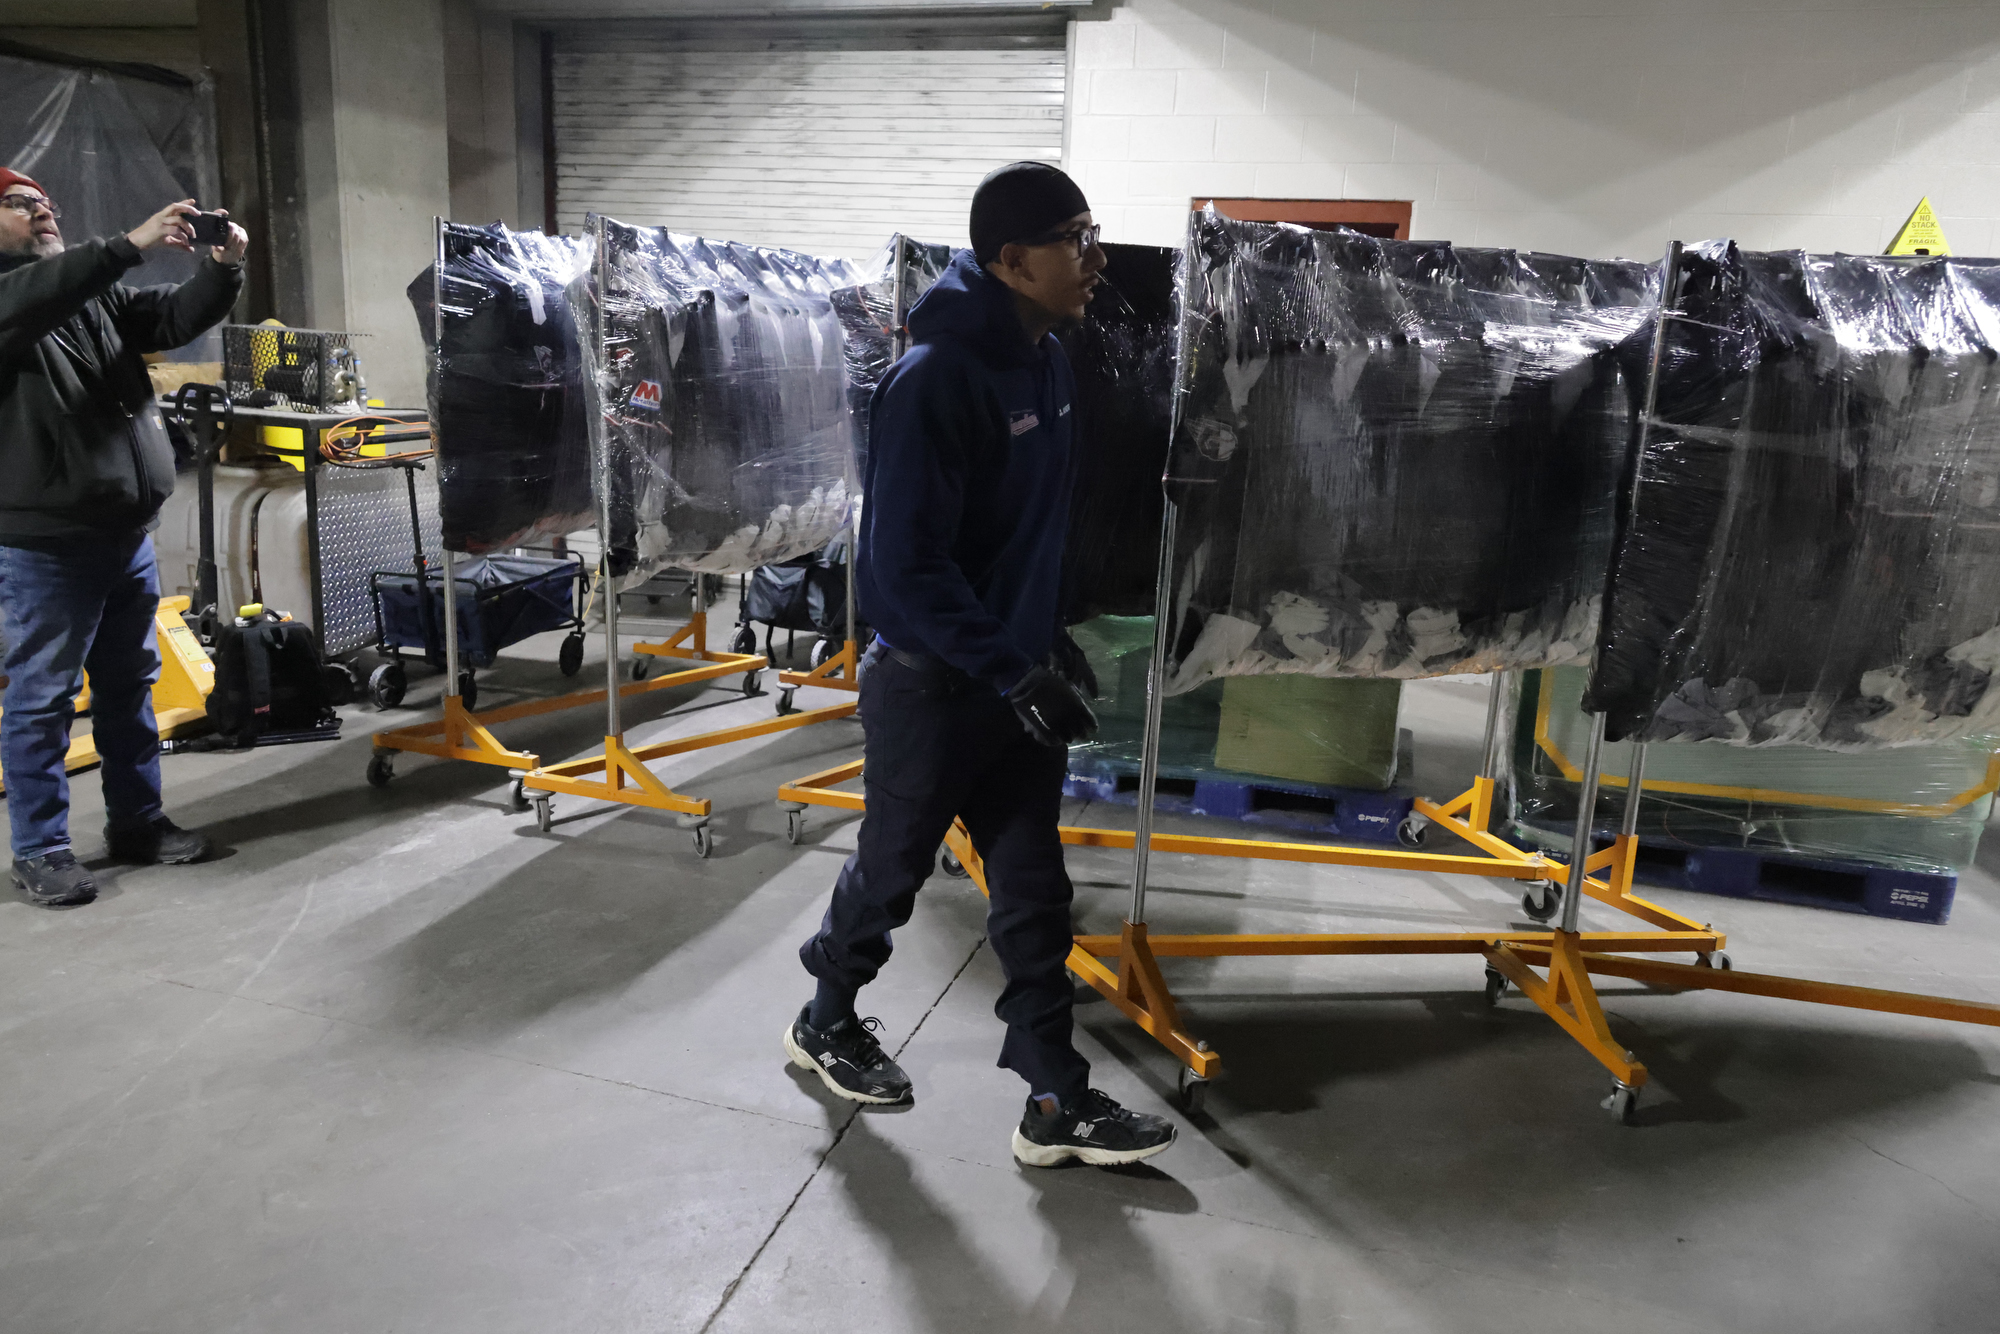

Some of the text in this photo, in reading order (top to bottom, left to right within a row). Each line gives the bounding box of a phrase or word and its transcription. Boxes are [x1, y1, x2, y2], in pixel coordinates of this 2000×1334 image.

[1911, 221, 1936, 229] STACK
[1365, 815, 1389, 823] PEPSI
[1899, 894, 1929, 903] PEPSI
[819, 1051, 837, 1067] N
[1073, 1121, 1095, 1138] N
